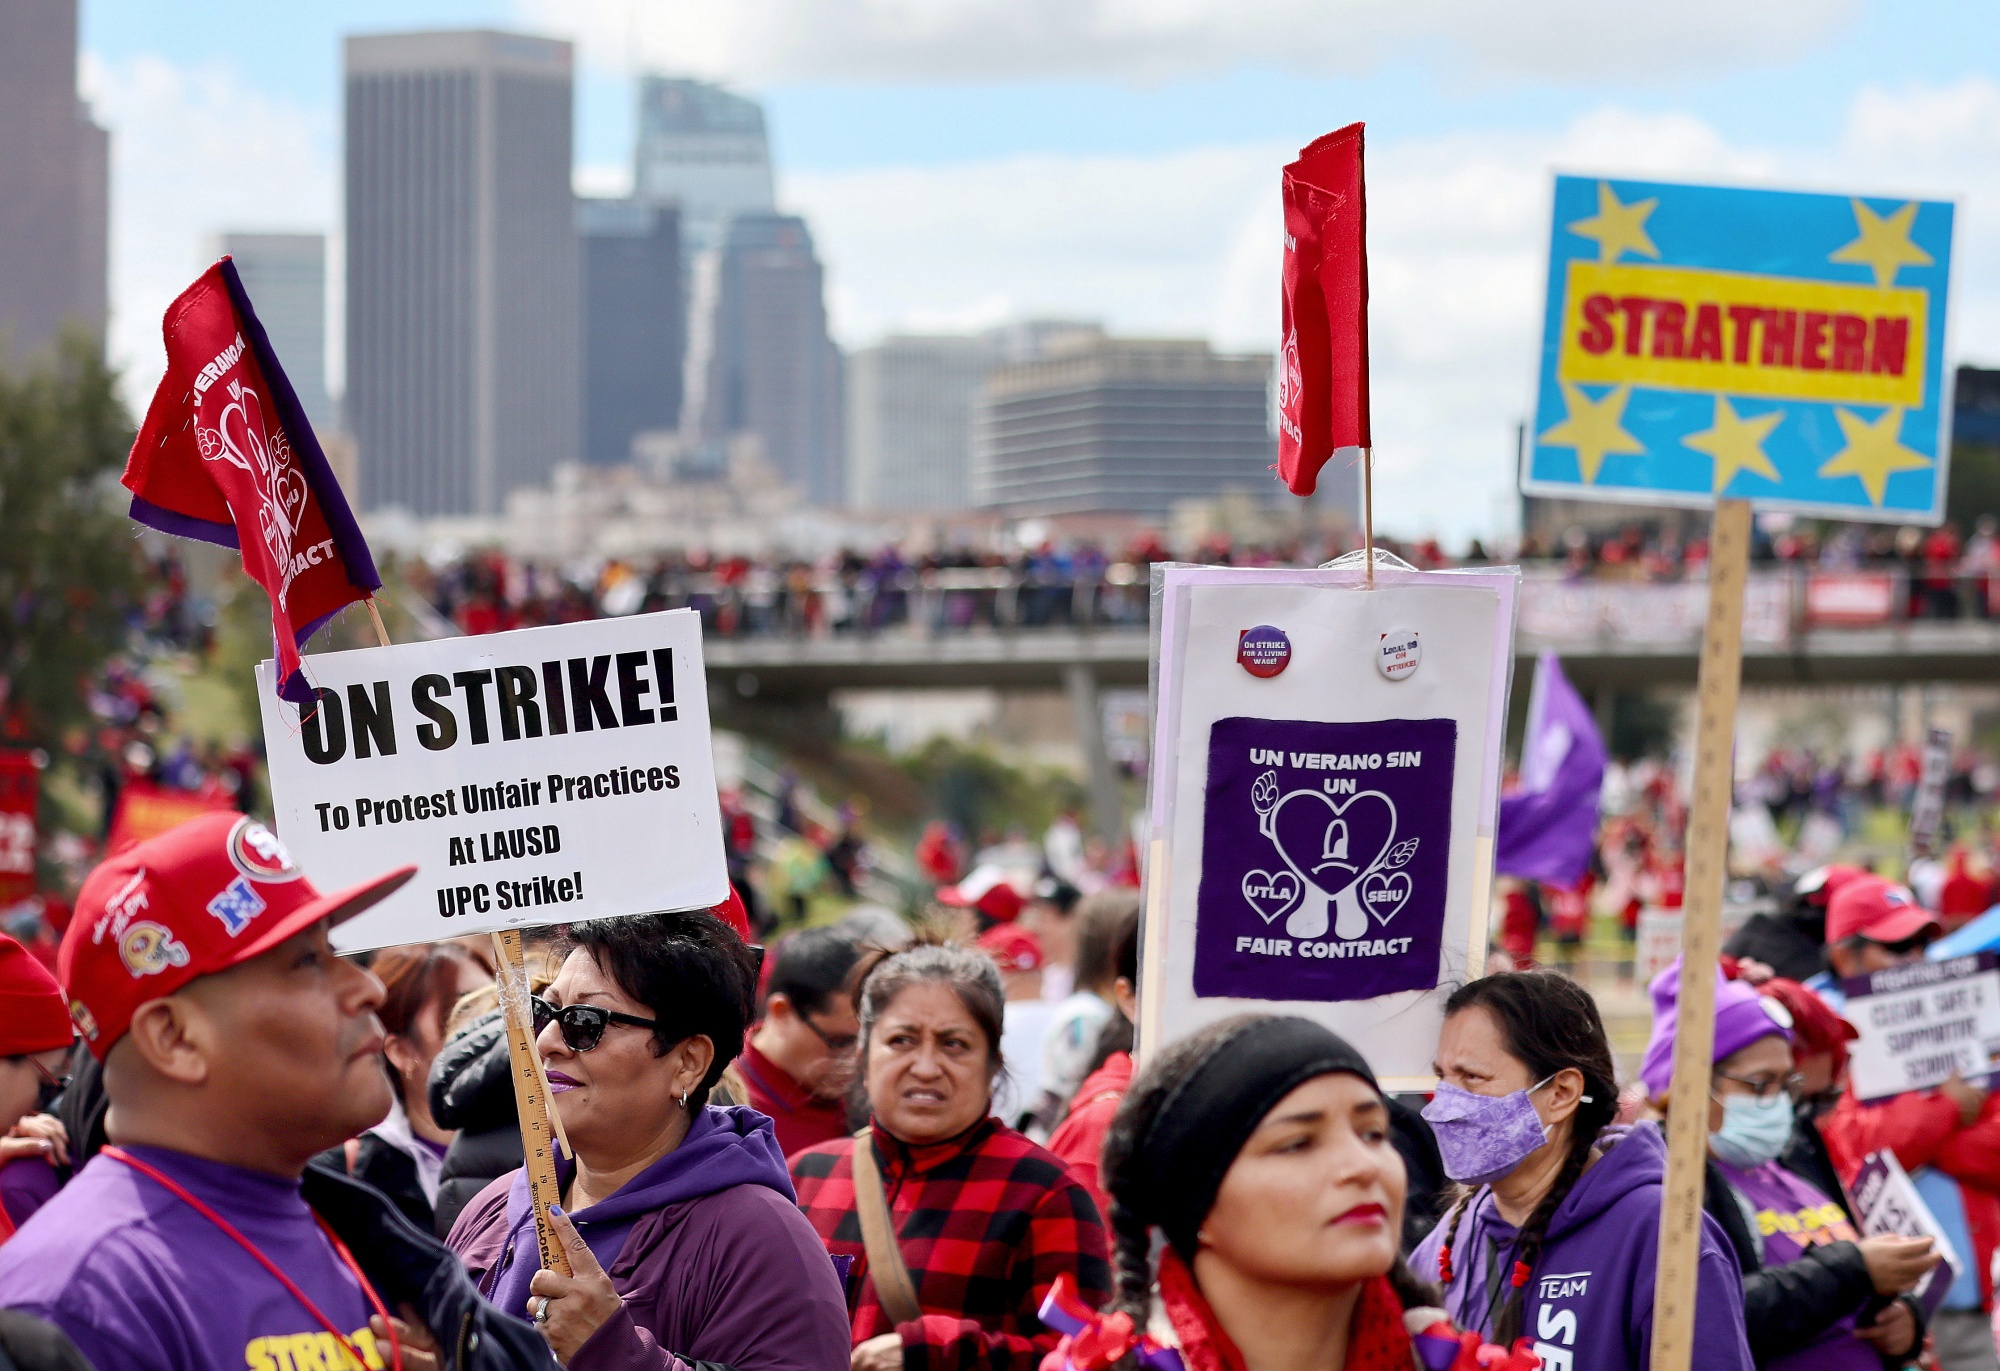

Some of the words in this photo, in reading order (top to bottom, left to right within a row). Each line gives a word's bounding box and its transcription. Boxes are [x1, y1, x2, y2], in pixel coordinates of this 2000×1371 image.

[1579, 293, 1909, 378] STRATHERN
[1256, 641, 1286, 649] STRIKE
[299, 680, 397, 765] ON
[411, 647, 678, 752] STRIKE!
[1249, 748, 1284, 767] UN
[1289, 752, 1382, 770] VERANO
[1386, 751, 1422, 768] SIN
[1323, 778, 1356, 794] UN
[315, 803, 349, 833] To
[356, 788, 458, 828] Protest
[462, 777, 542, 814] Unfair
[548, 764, 680, 802] Practices
[449, 836, 475, 866] At
[481, 824, 561, 862] LAUSD
[437, 884, 491, 918] UPC
[497, 871, 584, 912] Strike!
[1246, 885, 1291, 901] UTLA
[1368, 889, 1404, 903] SEIU
[1235, 936, 1292, 957] FAIR
[1297, 937, 1413, 959] CONTRACT
[1539, 1280, 1588, 1299] TEAM
